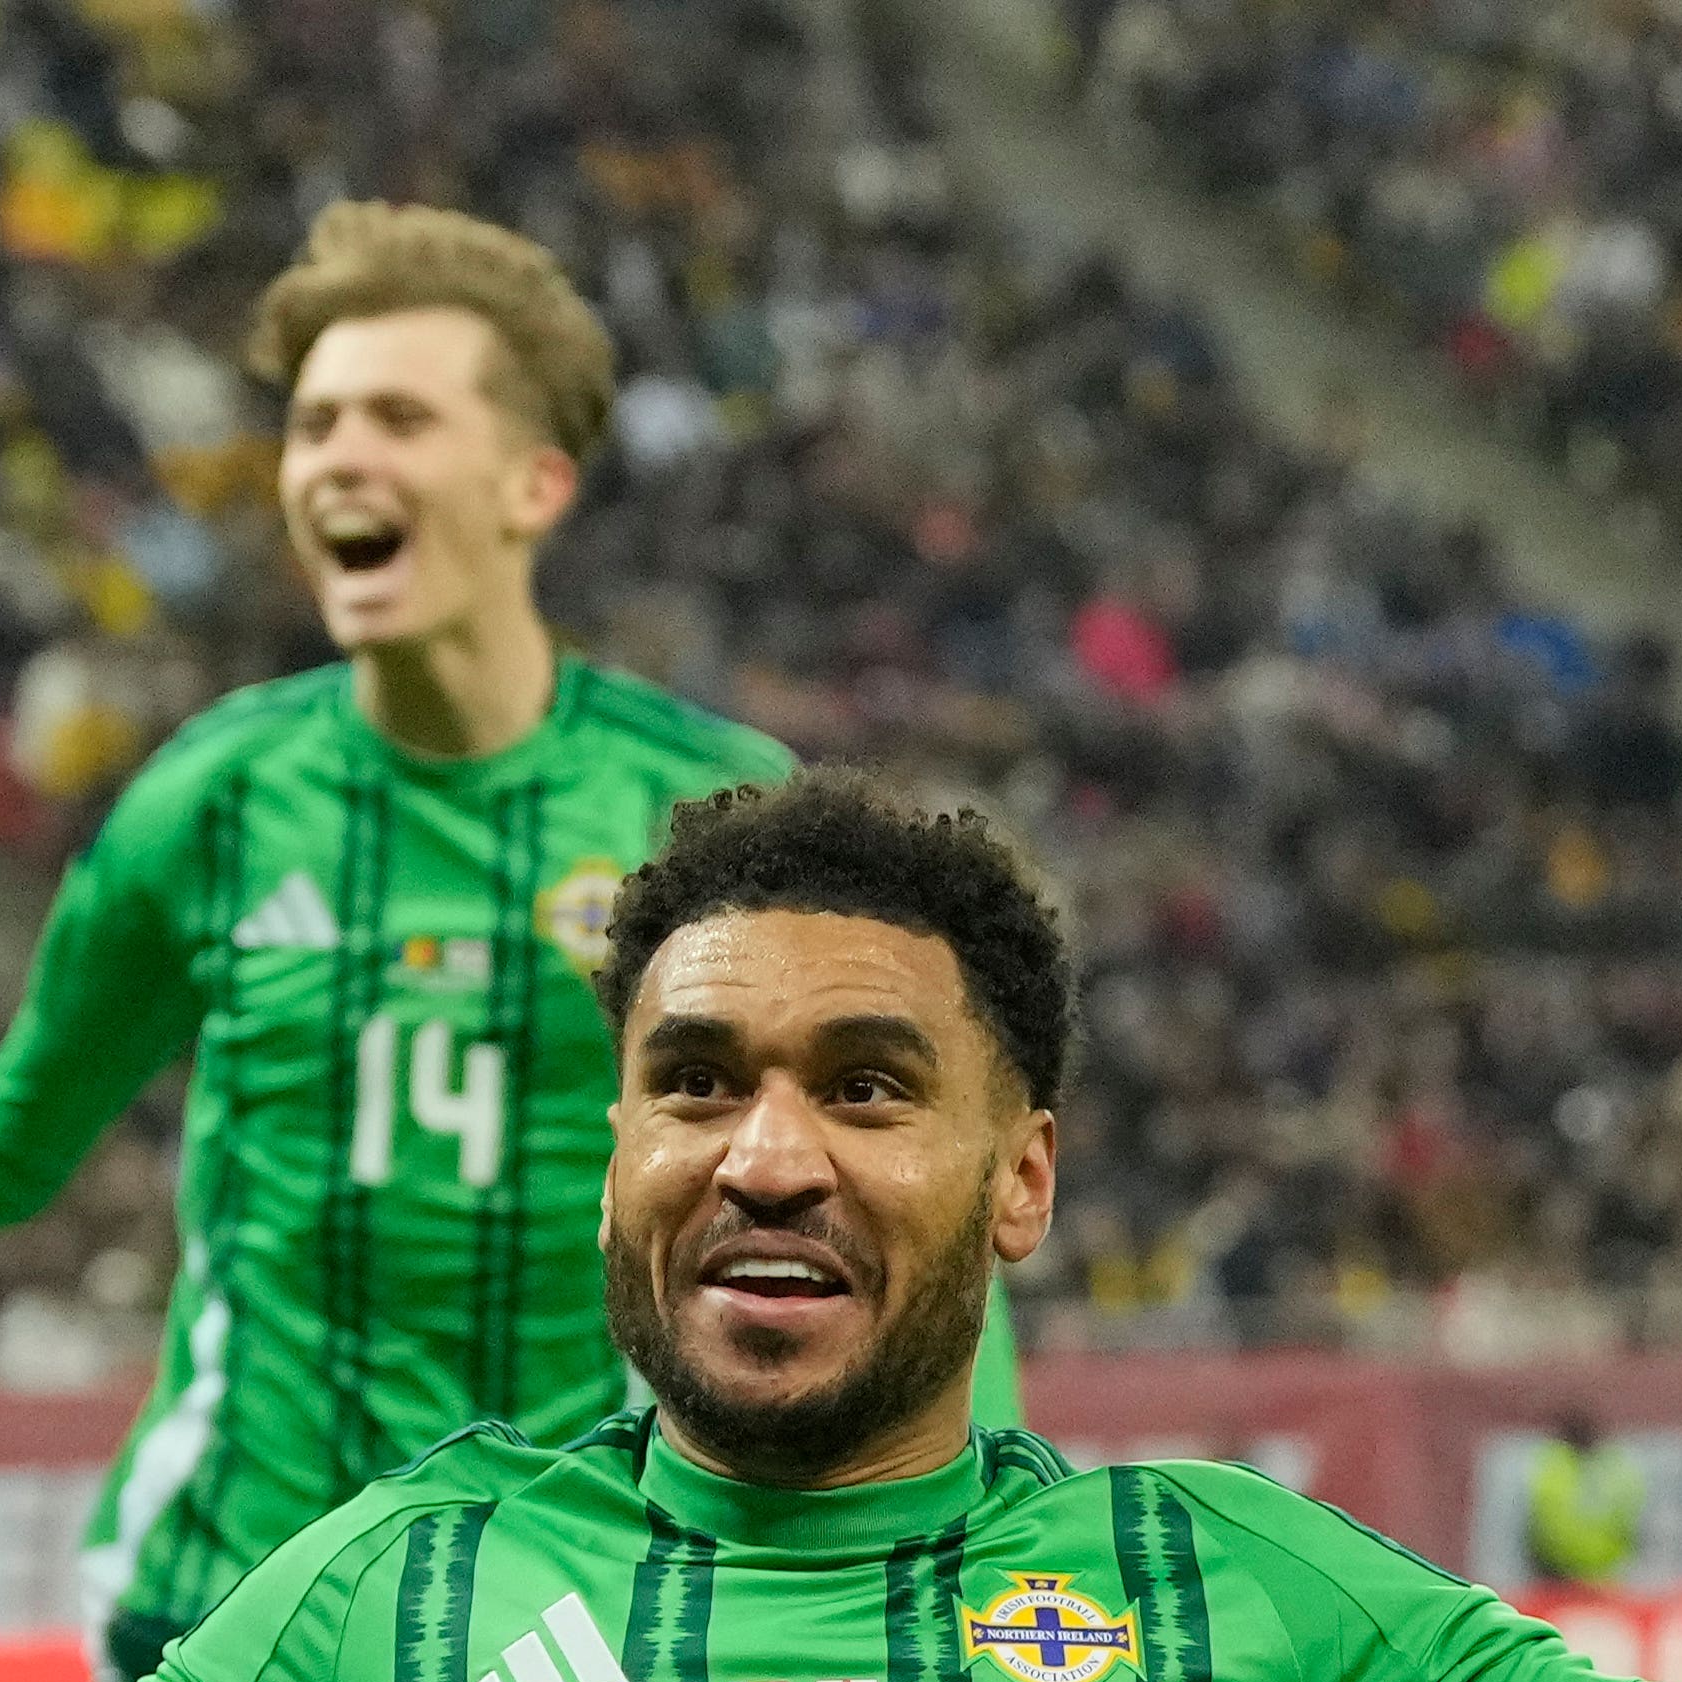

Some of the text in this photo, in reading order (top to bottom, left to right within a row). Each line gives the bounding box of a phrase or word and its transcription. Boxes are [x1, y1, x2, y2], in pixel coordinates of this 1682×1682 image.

[350, 1015, 507, 1187] 14
[996, 1593, 1097, 1623] IRISH FOOTBALL
[987, 1628, 1113, 1643] NORTHERN IRELAND
[1005, 1655, 1101, 1682] ASSOCIATION
